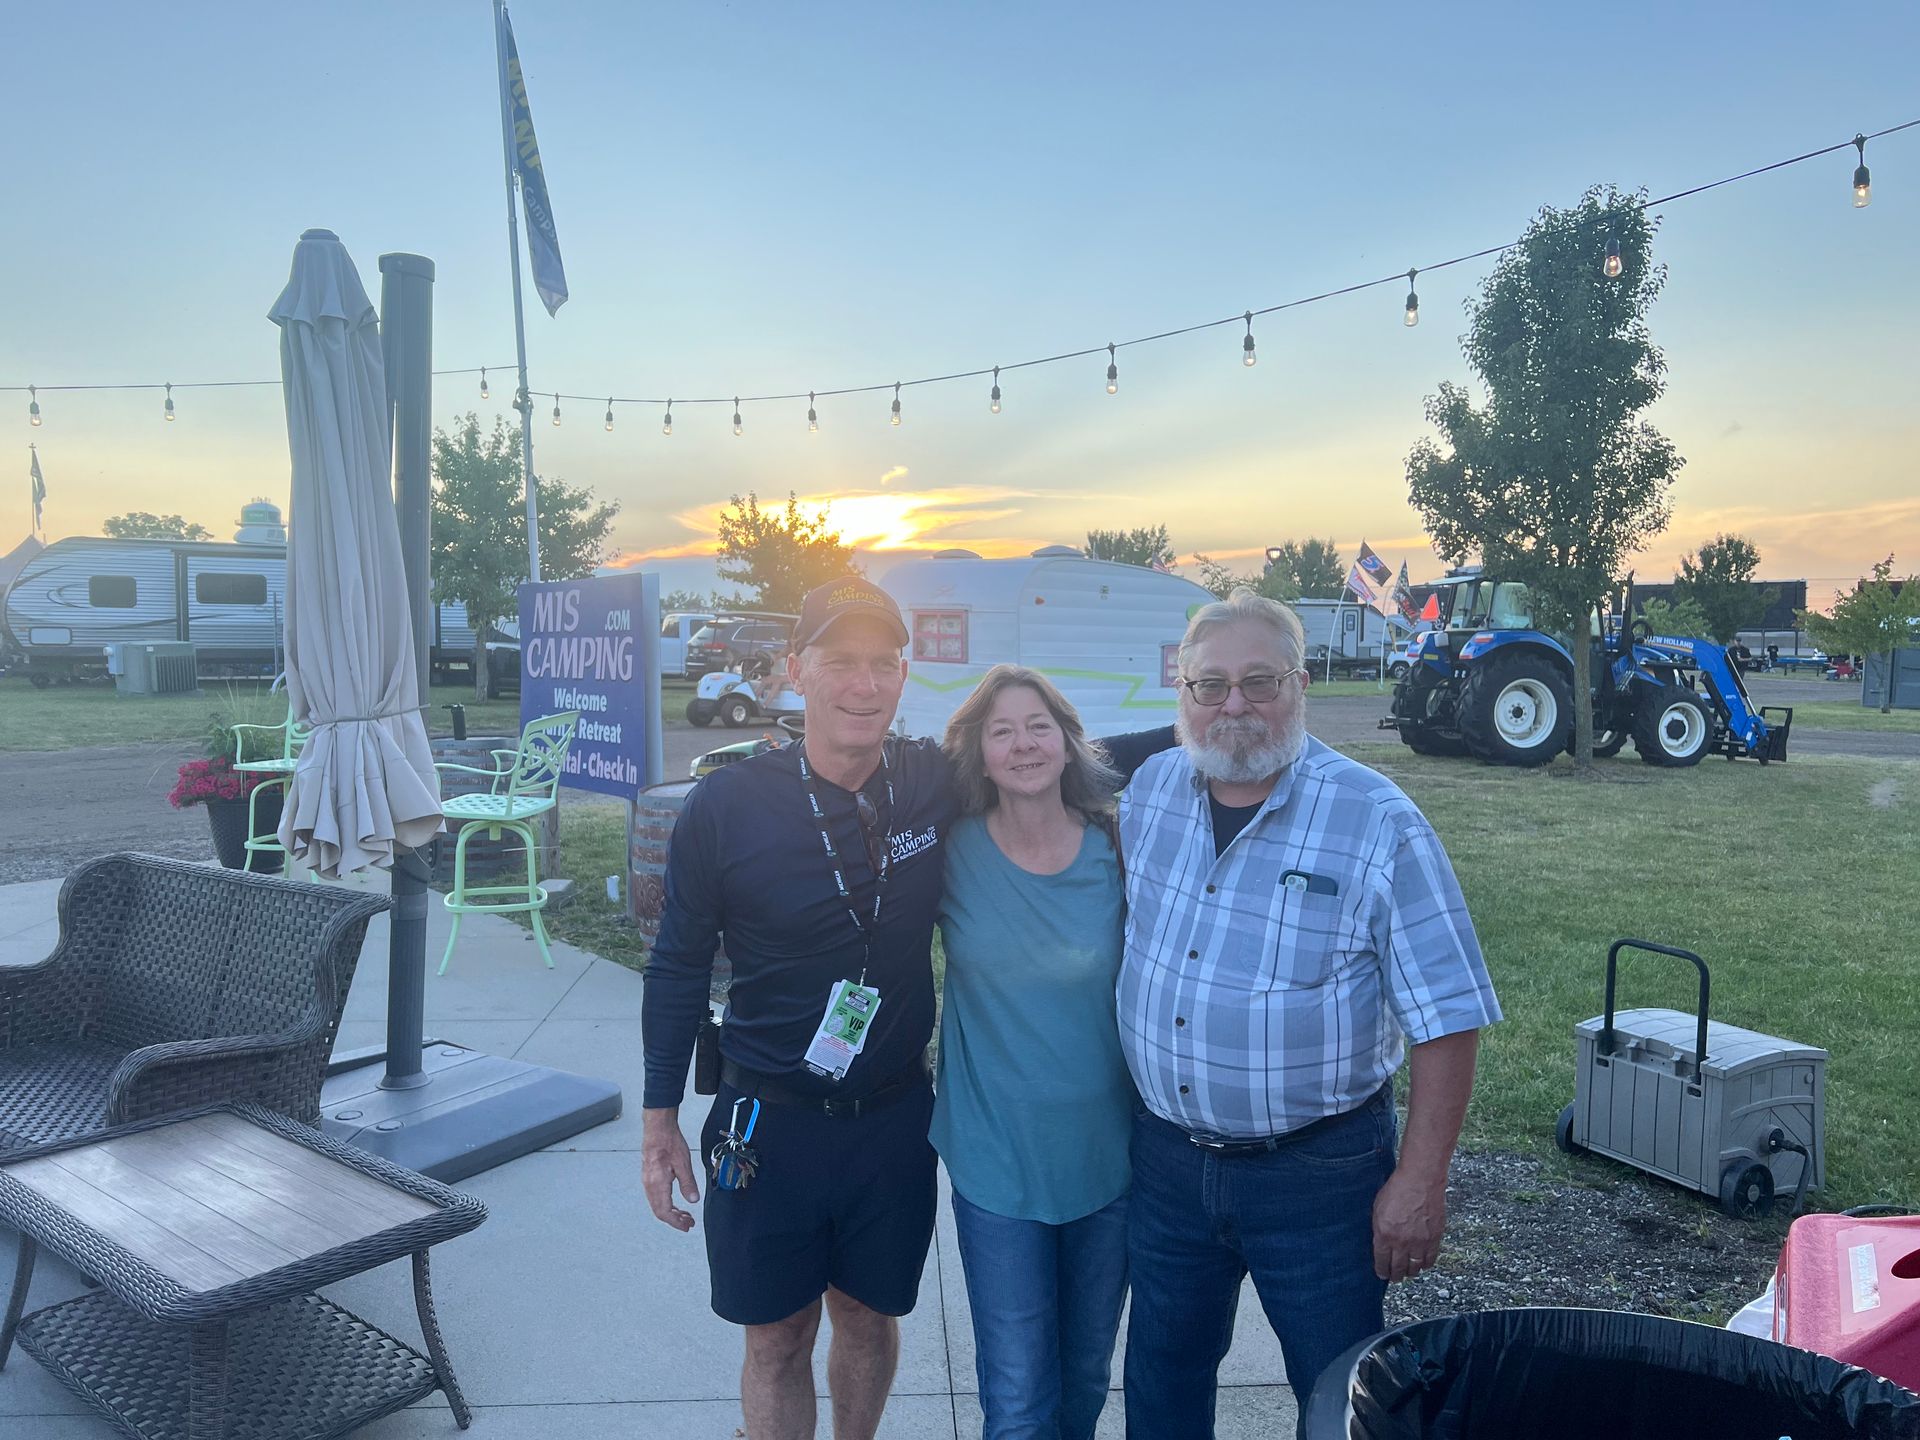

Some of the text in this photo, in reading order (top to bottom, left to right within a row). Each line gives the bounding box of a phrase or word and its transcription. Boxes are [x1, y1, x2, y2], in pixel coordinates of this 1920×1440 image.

[532, 589, 580, 633] MIS
[604, 609, 630, 632] .COM
[1663, 637, 1694, 649] HOLLAND
[526, 636, 633, 681] CAMPING
[554, 687, 607, 713] Welcome
[578, 718, 622, 744] Retreat
[587, 751, 625, 782] Check
[625, 758, 638, 785] In
[890, 828, 936, 858] CAMPING
[891, 829, 913, 848] MIS
[849, 1015, 865, 1032] VIP
